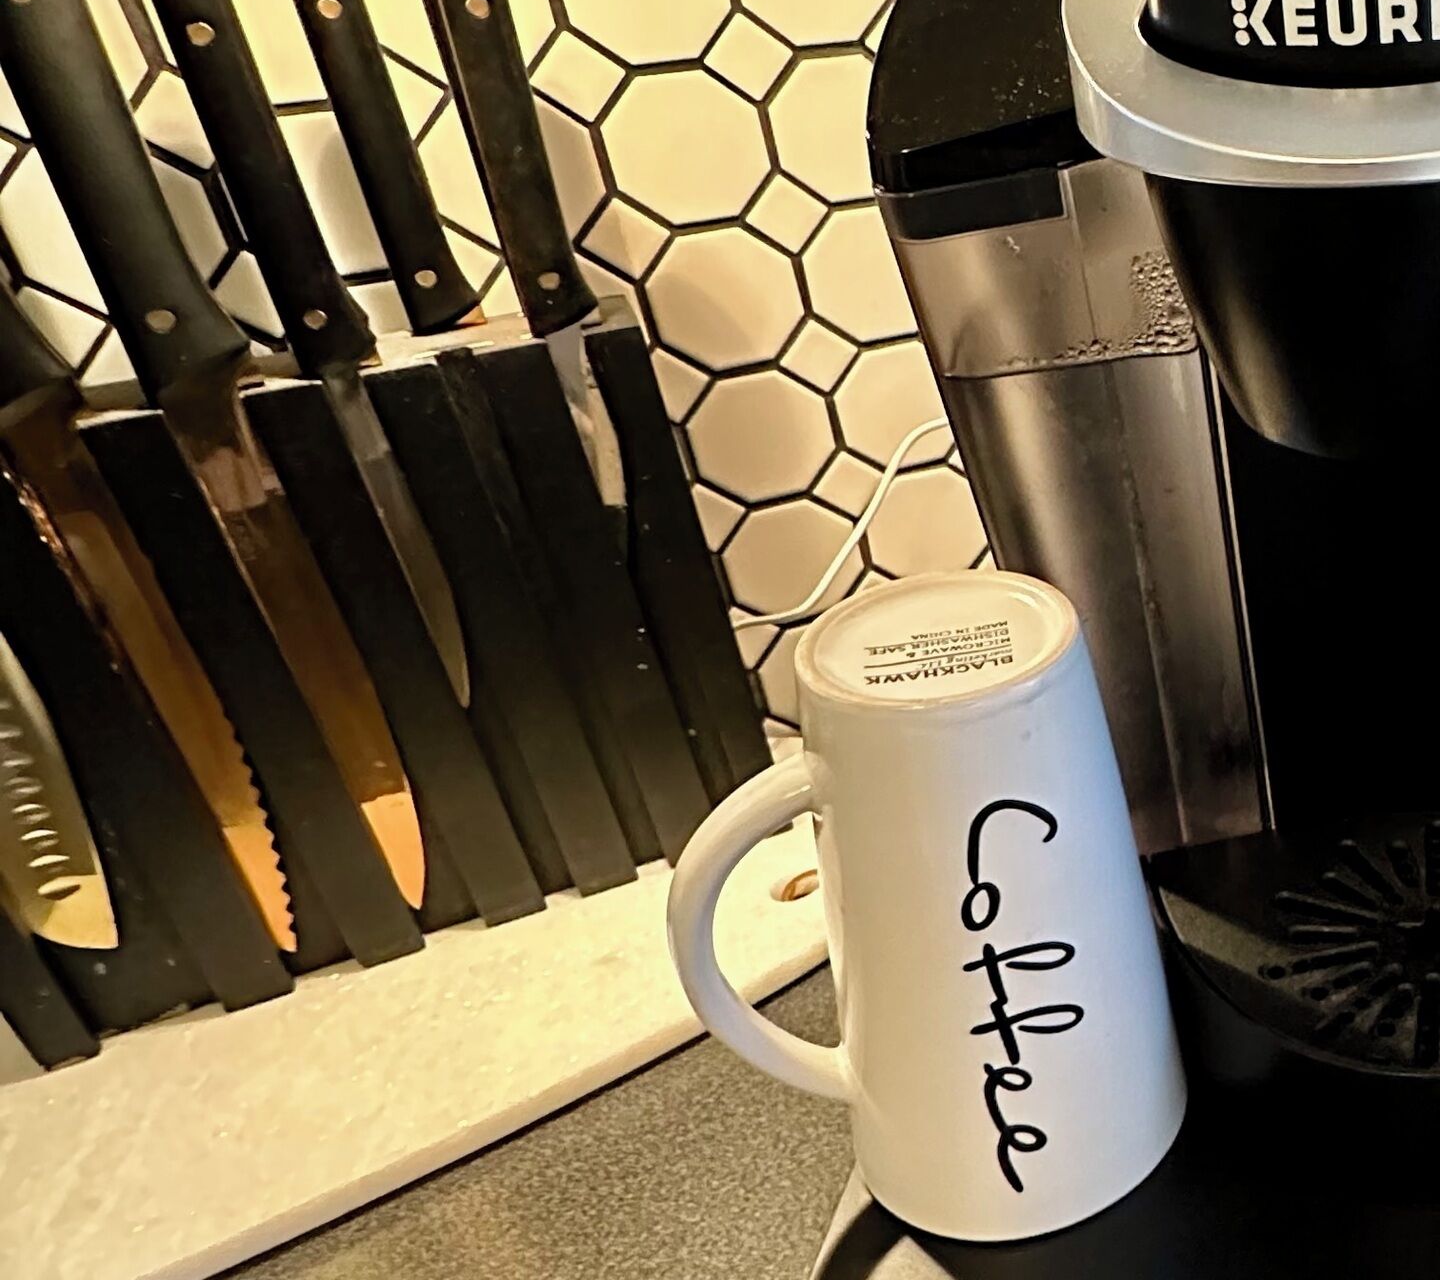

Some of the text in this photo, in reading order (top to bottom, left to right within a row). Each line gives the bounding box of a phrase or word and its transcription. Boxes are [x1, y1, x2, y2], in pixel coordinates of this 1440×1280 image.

[911, 630, 952, 640] CHINA
[974, 620, 1008, 631] MADE
[868, 627, 1009, 656] DISHWASHER SAFE
[922, 637, 1011, 655] MICROWAVE
[866, 654, 1013, 686] BLACKHAWK
[961, 799, 1084, 1193] Coffee
